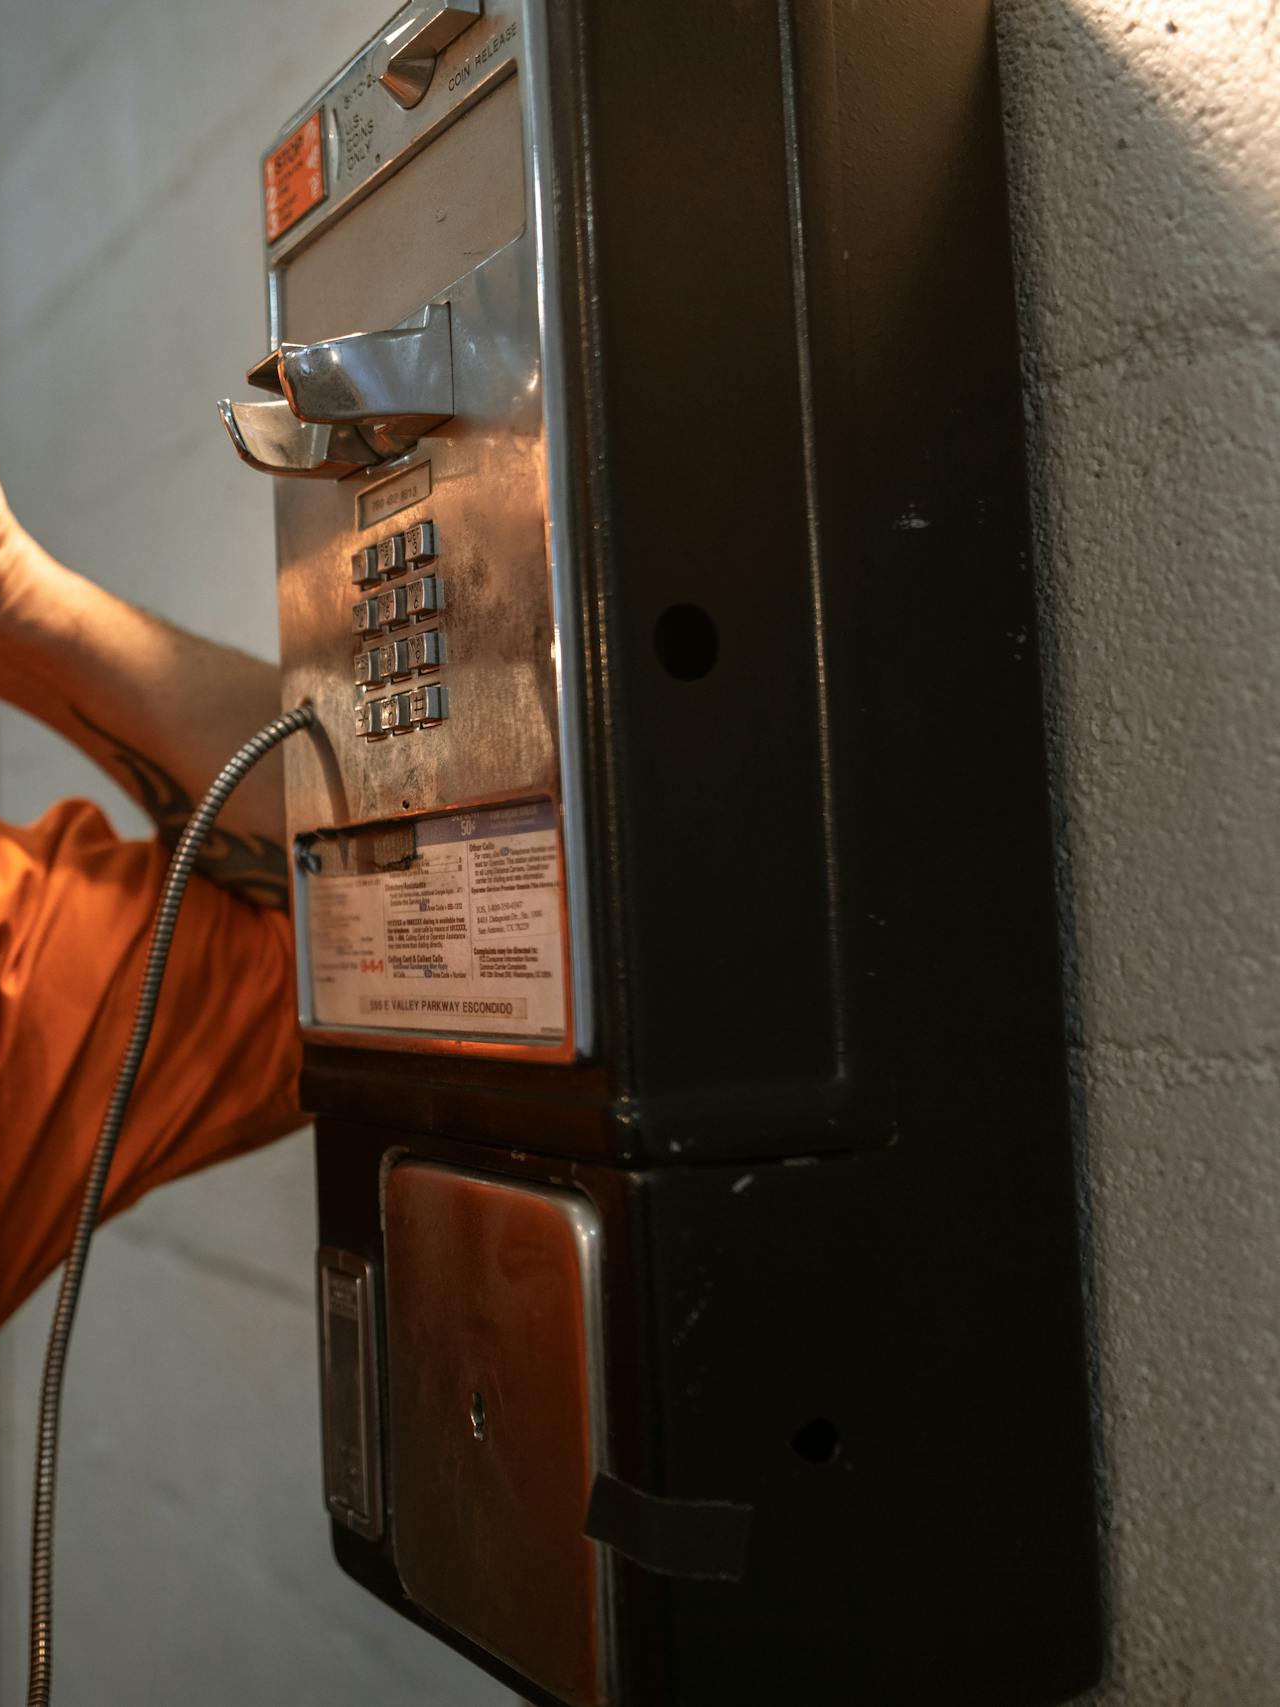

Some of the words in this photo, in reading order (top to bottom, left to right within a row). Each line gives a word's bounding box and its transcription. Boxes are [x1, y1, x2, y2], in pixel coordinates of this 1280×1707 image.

[448, 64, 470, 91] COIN
[474, 22, 517, 70] RELEASE
[391, 1000, 419, 1012] VALLEY
[421, 1000, 460, 1012] PARKWAY
[462, 1001, 513, 1015] ESCONDIDO
